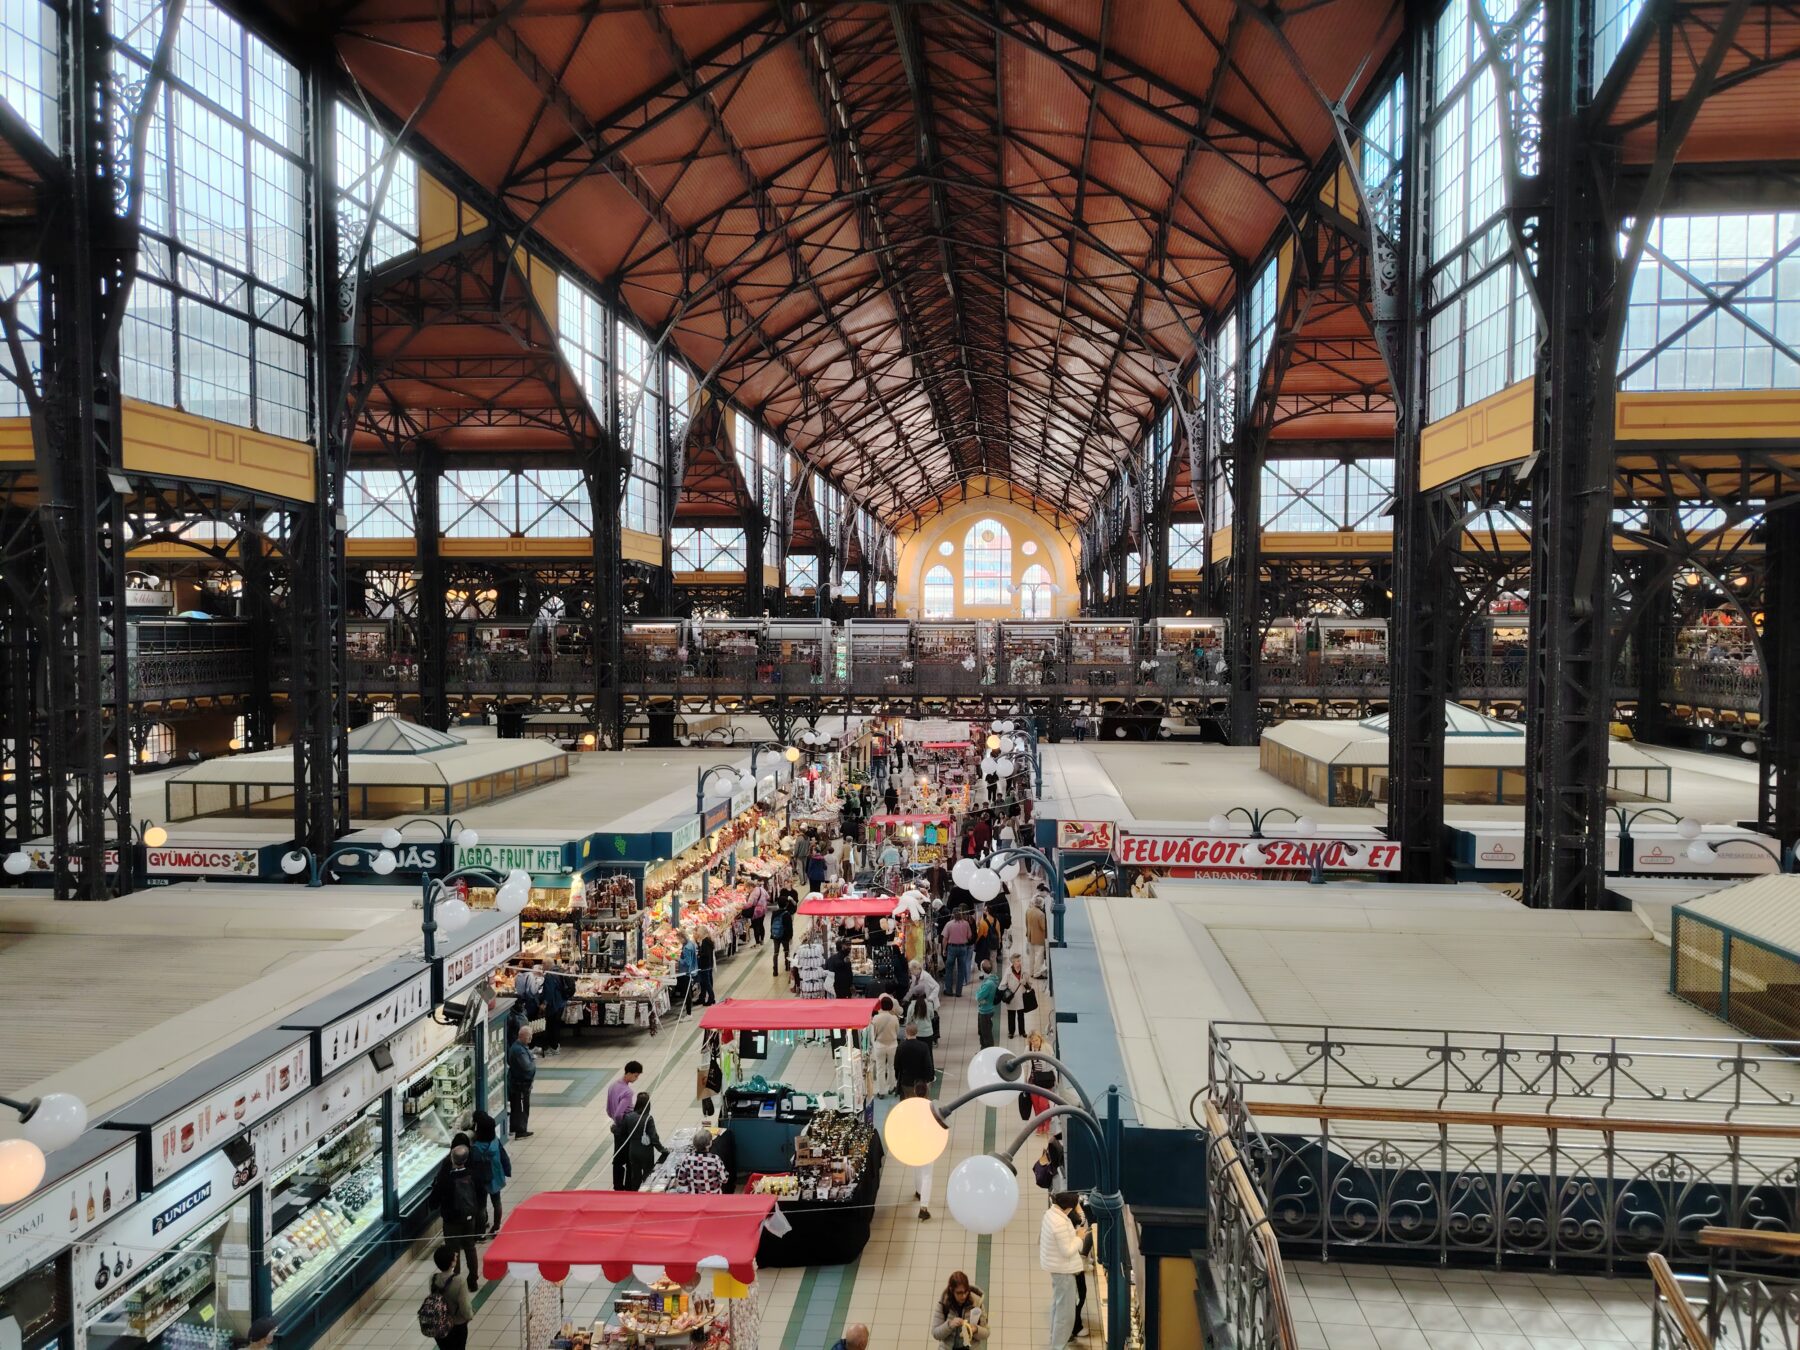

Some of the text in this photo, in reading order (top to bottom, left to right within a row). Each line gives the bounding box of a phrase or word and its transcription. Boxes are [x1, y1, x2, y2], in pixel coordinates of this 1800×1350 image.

[148, 850, 231, 868] GYÜMÖLCS
[367, 846, 437, 869] JÁS
[458, 847, 560, 870] AGRO-FRUIT KFT.
[1194, 871, 1258, 881] KABANOS
[164, 1184, 212, 1224] UNICUM
